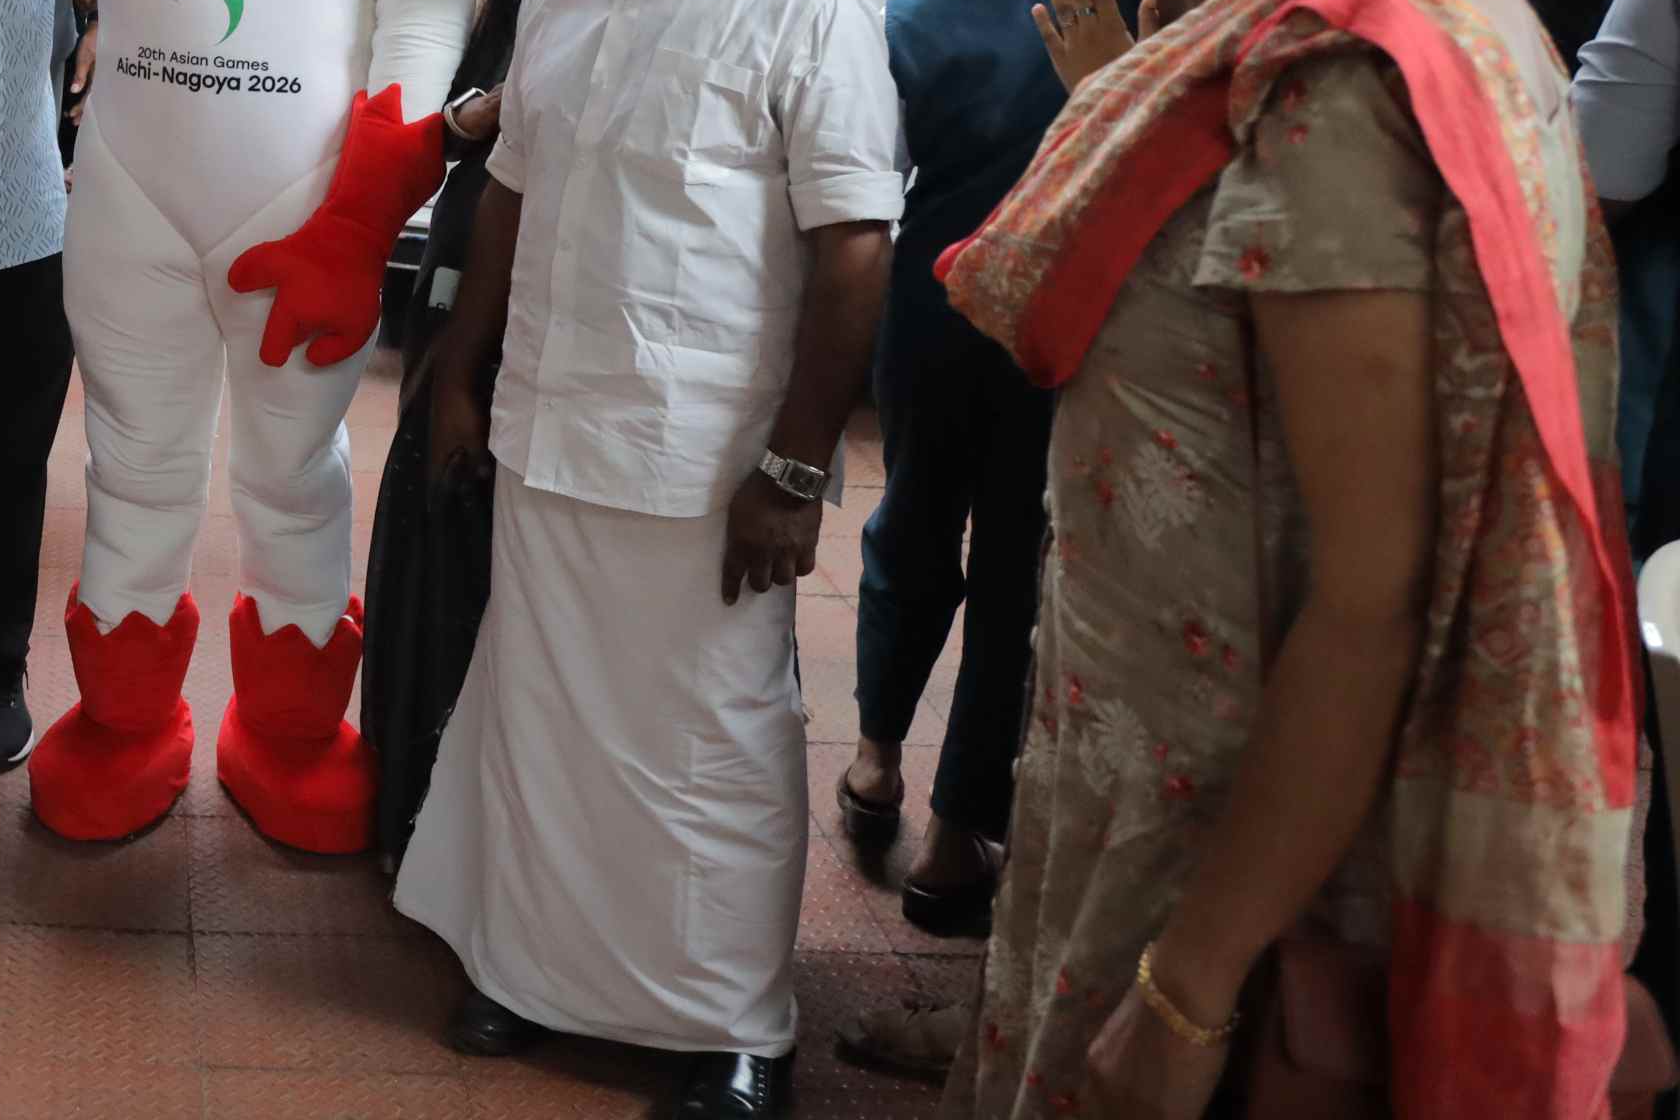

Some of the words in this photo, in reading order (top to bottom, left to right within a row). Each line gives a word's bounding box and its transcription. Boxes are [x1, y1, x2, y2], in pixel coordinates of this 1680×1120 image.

[138, 46, 166, 62] 20th
[170, 50, 209, 67] Asian
[213, 55, 269, 72] Games
[117, 57, 241, 95] Aichi-Nagoya
[248, 74, 302, 94] 2026
